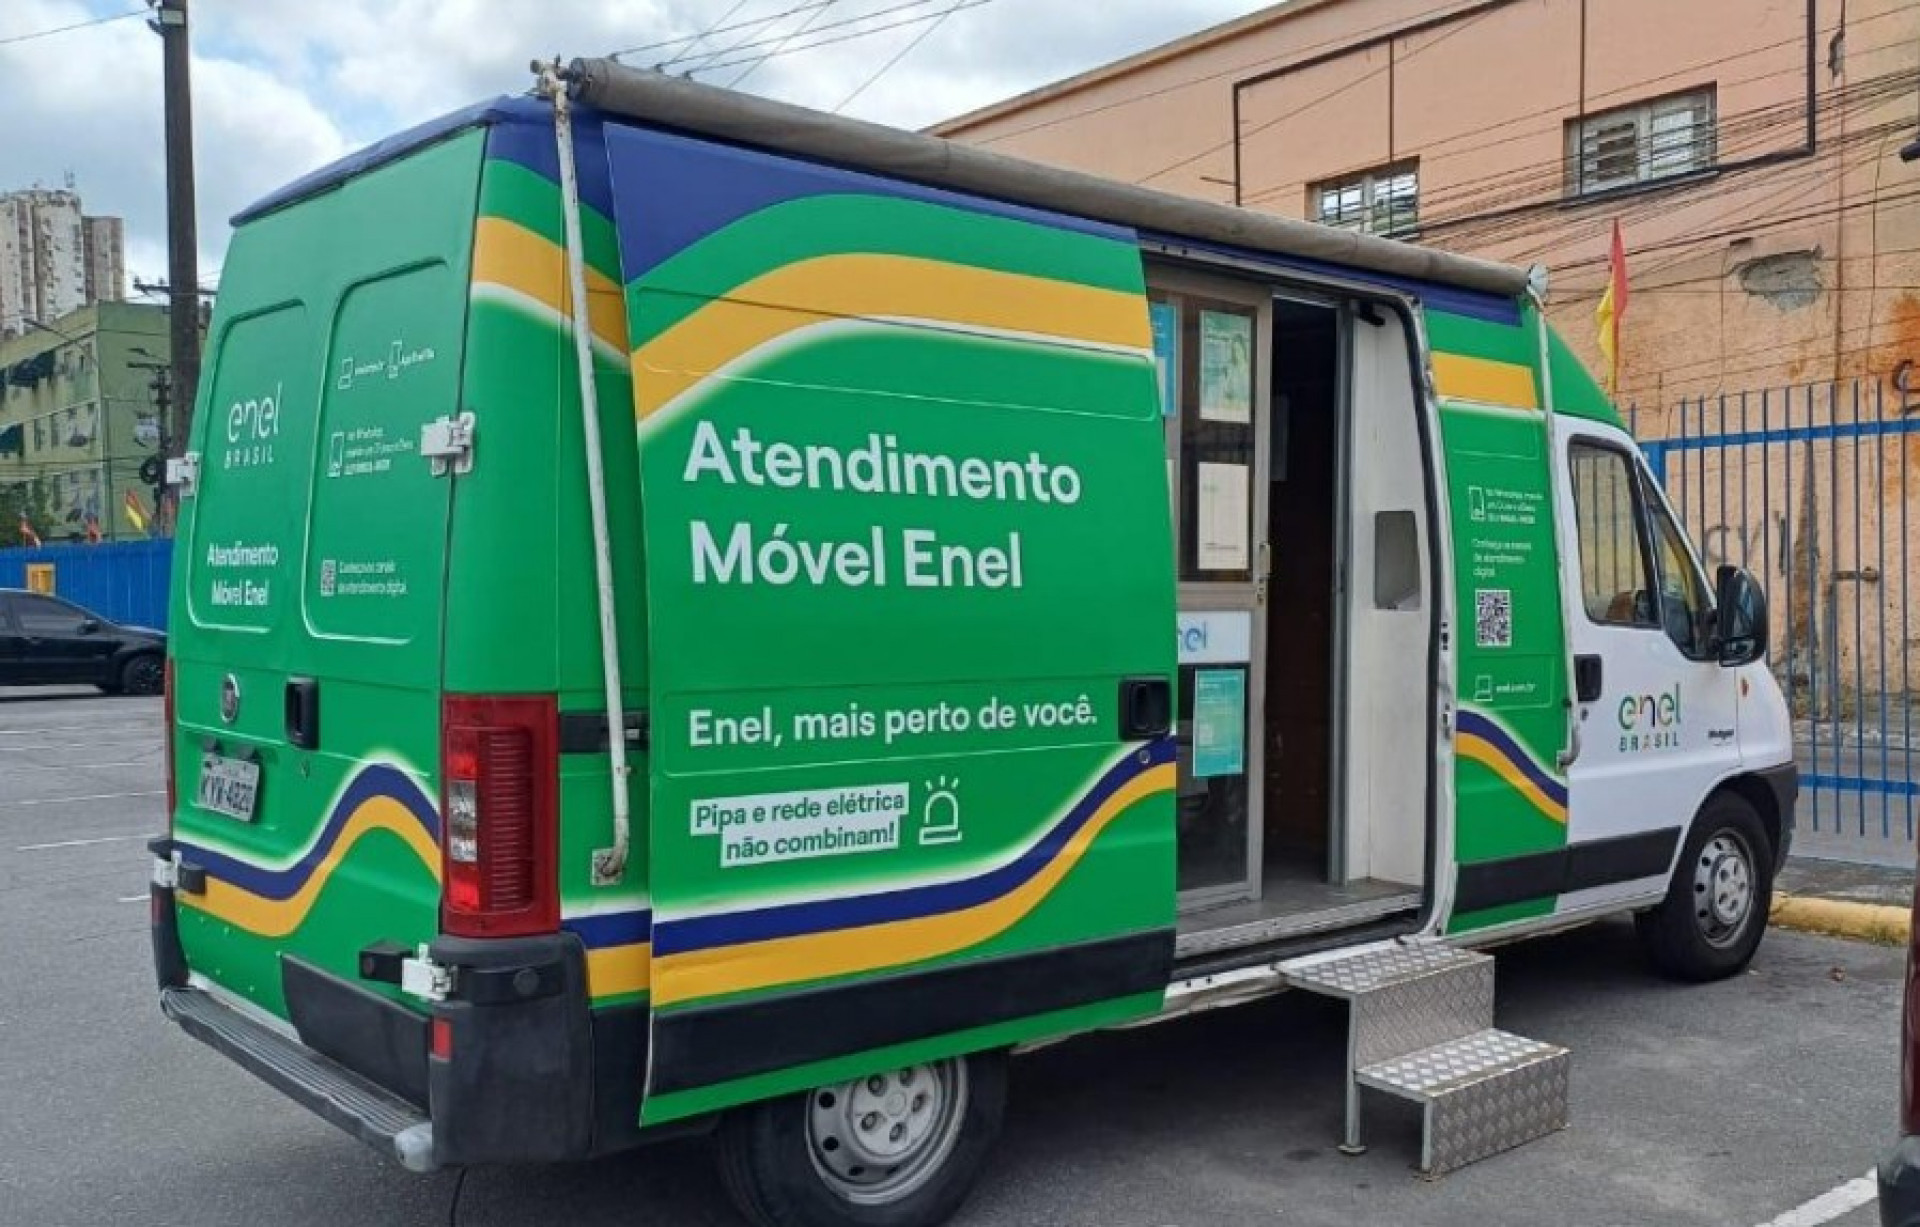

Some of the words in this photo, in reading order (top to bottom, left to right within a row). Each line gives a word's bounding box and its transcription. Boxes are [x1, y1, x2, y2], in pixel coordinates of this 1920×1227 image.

[228, 381, 283, 443] enel
[223, 444, 274, 469] BRASIL
[683, 420, 1081, 503] Atendimento
[207, 540, 278, 567] Atendimento
[690, 520, 886, 586] Móvel
[903, 529, 1022, 588] Enel
[212, 579, 242, 606] Móvel
[245, 579, 270, 606] Enel
[689, 706, 782, 747] Enel,
[794, 703, 876, 741] mais
[885, 702, 970, 744] perto
[978, 697, 1016, 729] de
[1023, 694, 1097, 727] você.
[1618, 681, 1681, 730] enel
[1619, 731, 1679, 752] BRASIL
[696, 804, 746, 832] Pipa
[752, 806, 766, 822] e
[772, 797, 821, 820] rede
[827, 790, 905, 815] elétrica
[726, 837, 768, 860] não
[774, 822, 895, 854] combinam!
